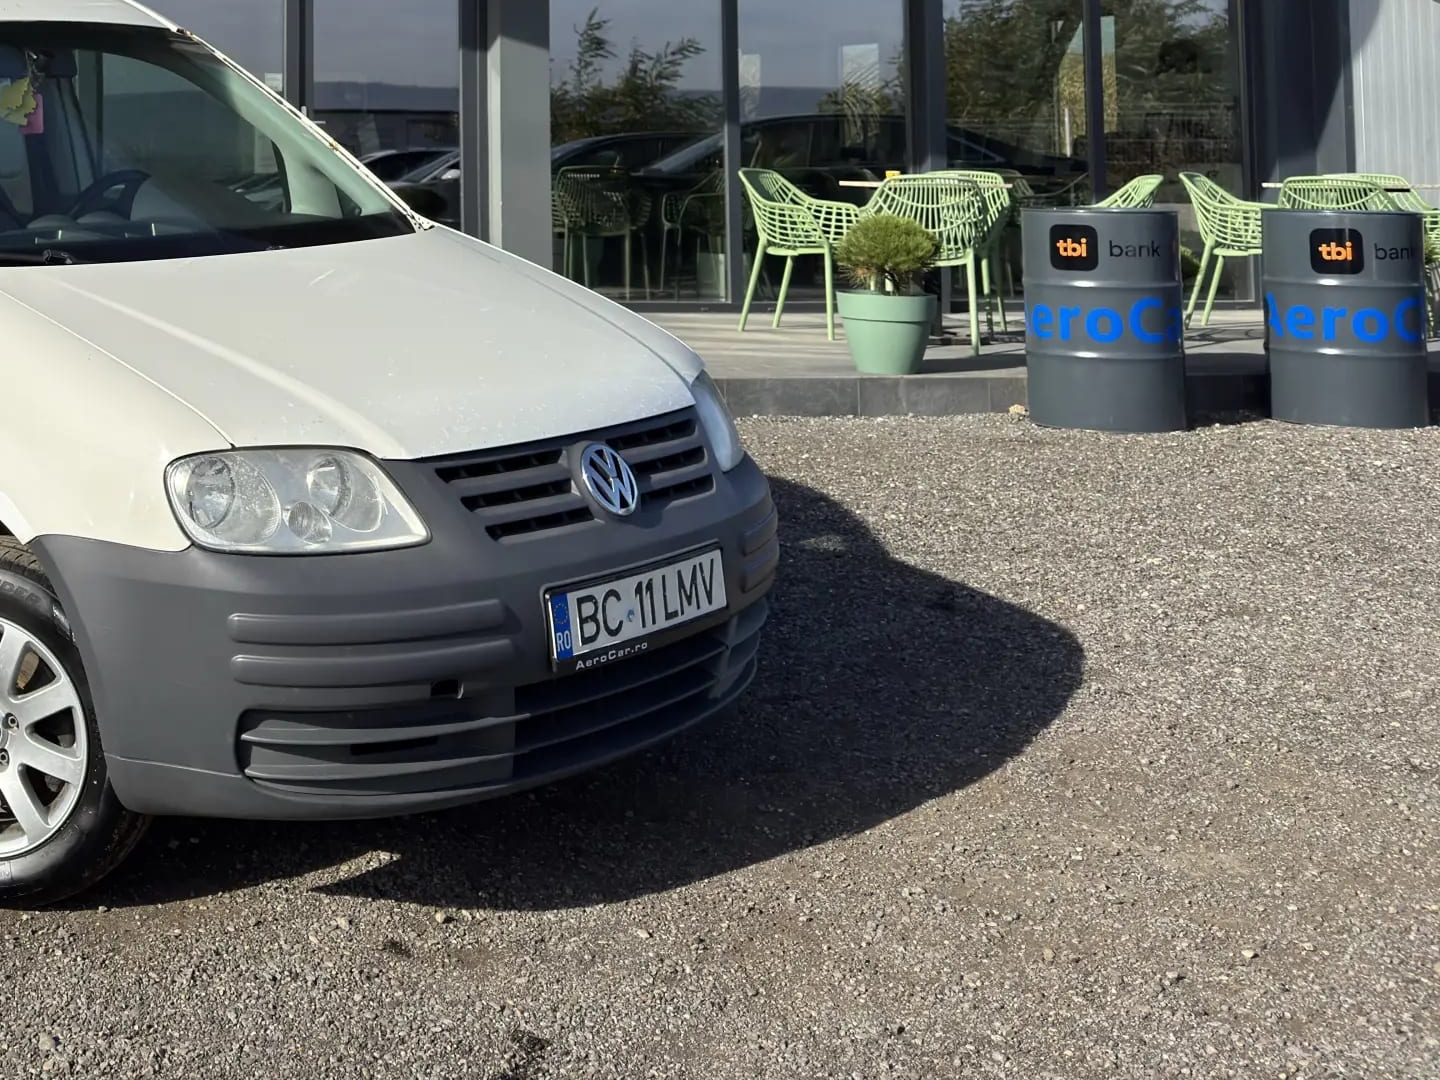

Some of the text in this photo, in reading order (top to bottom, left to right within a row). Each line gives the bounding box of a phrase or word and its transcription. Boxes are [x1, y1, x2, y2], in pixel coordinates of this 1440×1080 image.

[1056, 238, 1161, 258] tbi bank
[1318, 241, 1414, 261] tbi ban
[556, 558, 715, 652] RO BC 11 LMV
[575, 641, 648, 670] AeroCar.ro
